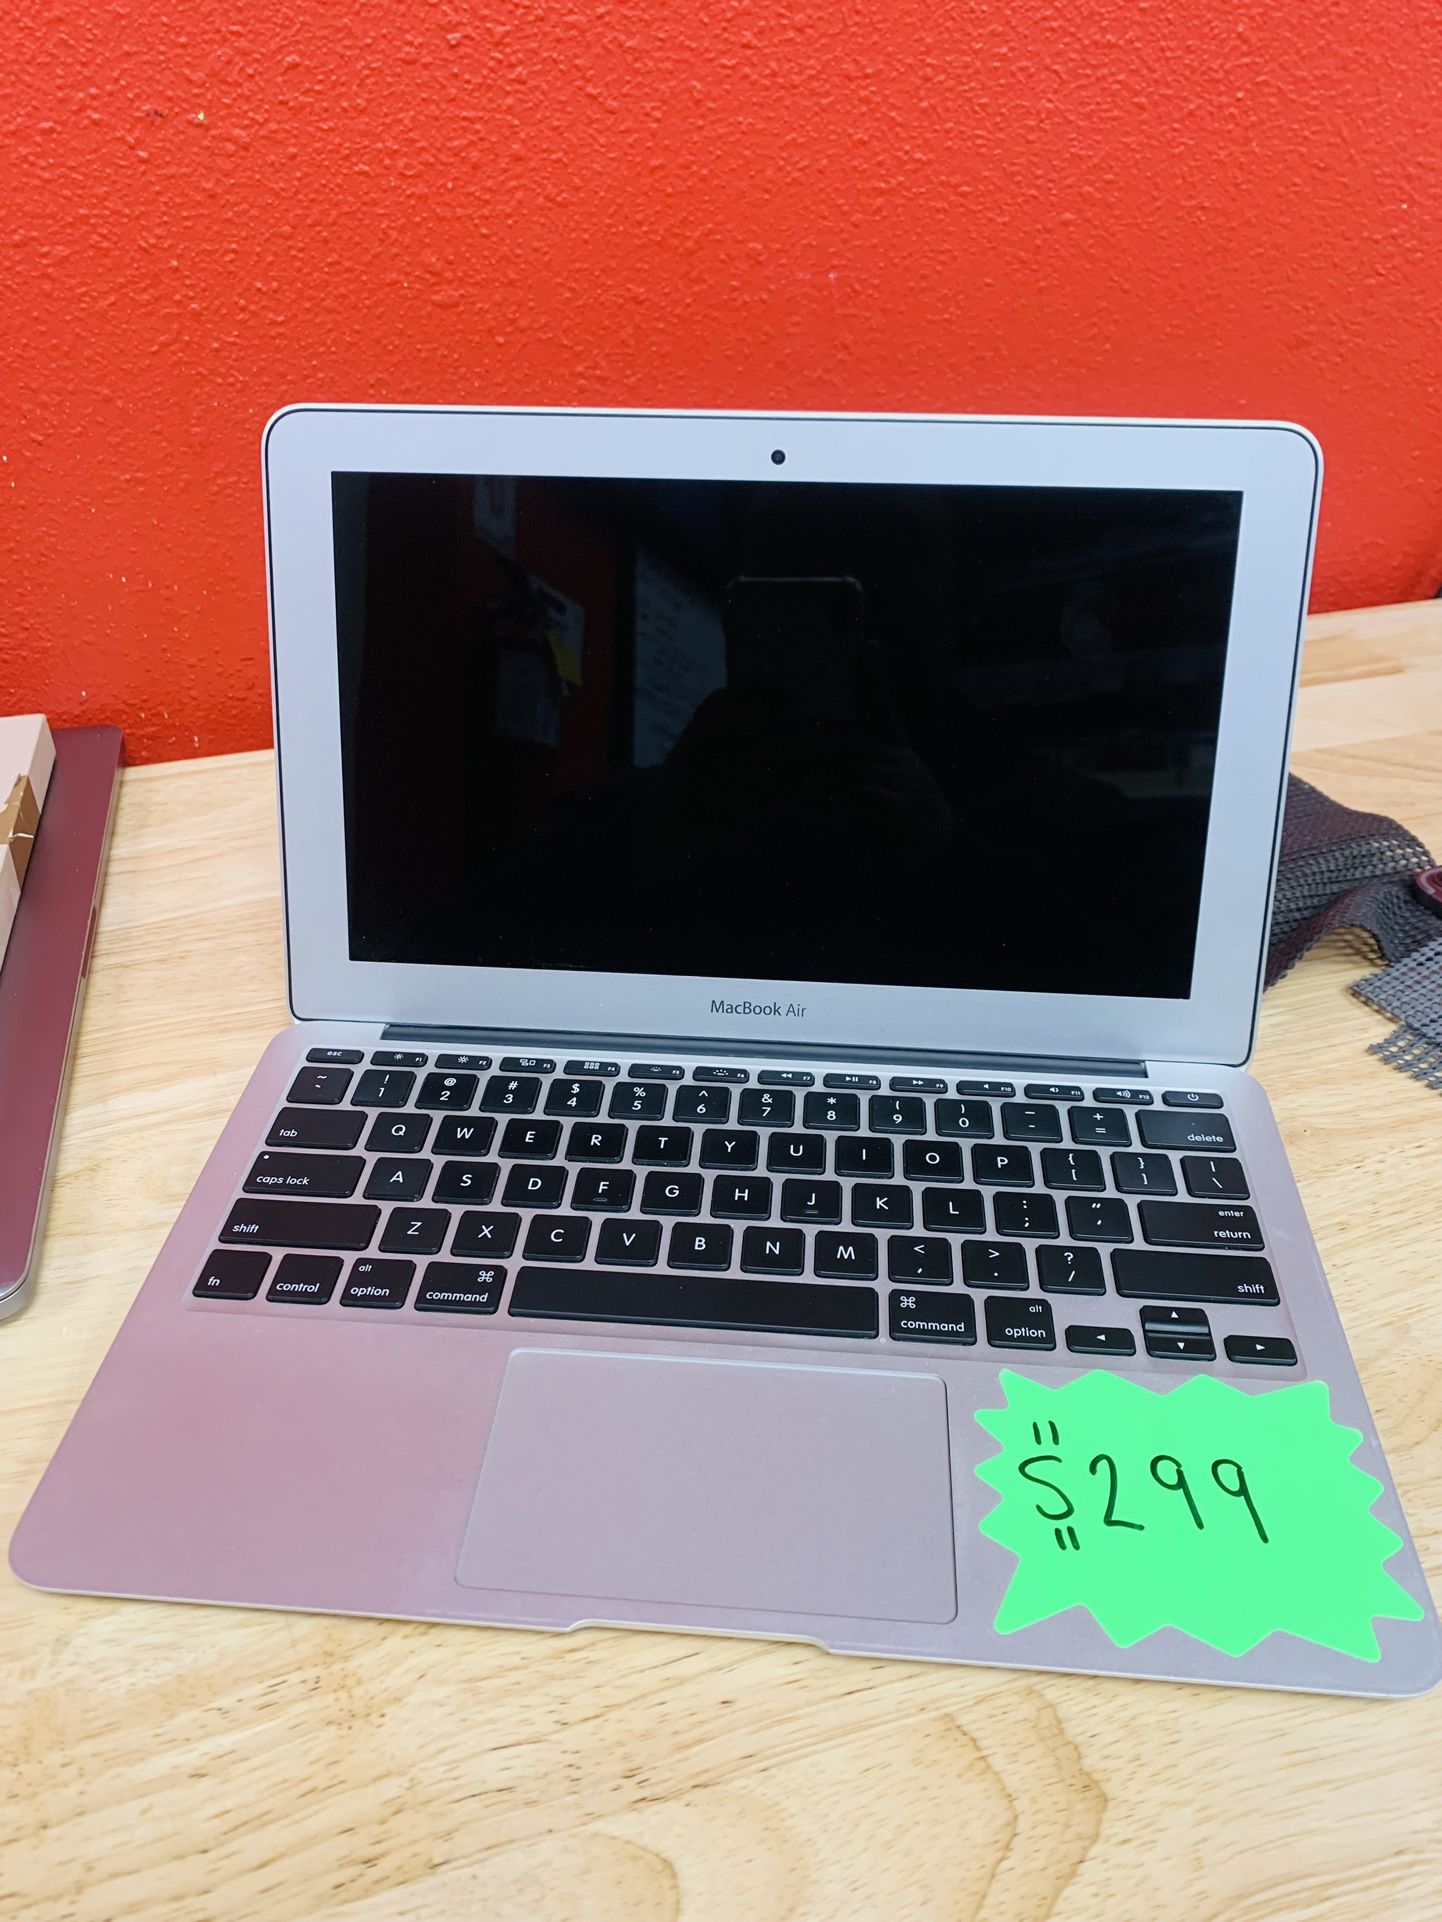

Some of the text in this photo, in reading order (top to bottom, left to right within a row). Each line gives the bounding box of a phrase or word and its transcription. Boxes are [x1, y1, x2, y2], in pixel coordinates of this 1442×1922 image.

[710, 999, 807, 1018] MacBook Air
[383, 1074, 390, 1084] !
[443, 1077, 457, 1087] @
[507, 1080, 519, 1091] #
[570, 1082, 580, 1094] $
[633, 1086, 646, 1097] %
[378, 1087, 385, 1098] 1
[439, 1090, 451, 1101] 2
[503, 1093, 514, 1104] 3
[761, 1093, 773, 1104] &
[566, 1096, 577, 1107] 4
[631, 1100, 643, 1111] 5
[895, 1100, 900, 1111] (
[696, 1103, 707, 1114] 6
[761, 1106, 772, 1117] 7
[960, 1103, 965, 1114] )
[826, 1110, 837, 1121] 8
[892, 1113, 903, 1124] 9
[1092, 1112, 1104, 1121] +
[279, 1128, 298, 1137] tab
[391, 1124, 406, 1136] Q
[456, 1127, 474, 1139] W
[524, 1130, 536, 1143] E
[590, 1134, 602, 1146] R
[1187, 1133, 1224, 1143] delete
[658, 1137, 669, 1149] T
[724, 1140, 736, 1153] Y
[789, 1144, 804, 1157] U
[862, 1148, 866, 1161] I
[925, 1152, 940, 1165] O
[996, 1156, 1009, 1169] P
[1068, 1153, 1076, 1166] {
[1137, 1157, 1145, 1169] }
[256, 1175, 310, 1185] caps lock
[389, 1170, 404, 1183] A
[460, 1174, 473, 1187] S
[1071, 1169, 1078, 1181] [
[1141, 1173, 1148, 1185] ]
[527, 1177, 542, 1190] D
[598, 1181, 610, 1194] F
[1211, 1177, 1223, 1189] \
[665, 1184, 680, 1198] G
[734, 1188, 749, 1201] H
[806, 1192, 816, 1206] J
[876, 1196, 889, 1210] K
[1022, 1200, 1028, 1209] :
[949, 1201, 960, 1215] L
[232, 1223, 259, 1233] shift
[406, 1221, 423, 1235] Z
[1024, 1217, 1030, 1228] ;
[477, 1224, 494, 1239] X
[550, 1228, 565, 1243] C
[1213, 1230, 1252, 1239] return
[622, 1232, 636, 1247] V
[694, 1236, 706, 1251] B
[765, 1240, 780, 1255] N
[836, 1245, 856, 1260] M
[913, 1244, 925, 1254] <
[988, 1248, 1000, 1258] >
[1063, 1252, 1074, 1265] ?
[358, 1264, 373, 1272] alt
[207, 1276, 221, 1287] fn
[1068, 1270, 1076, 1282] /
[276, 1282, 320, 1293] control
[350, 1286, 390, 1297] option
[1237, 1283, 1265, 1294] shift
[425, 1291, 489, 1302] command
[1028, 1304, 1043, 1313] alt
[900, 1320, 965, 1332] command
[1005, 1327, 1046, 1339] option
[1018, 1420, 1269, 1551] $299
